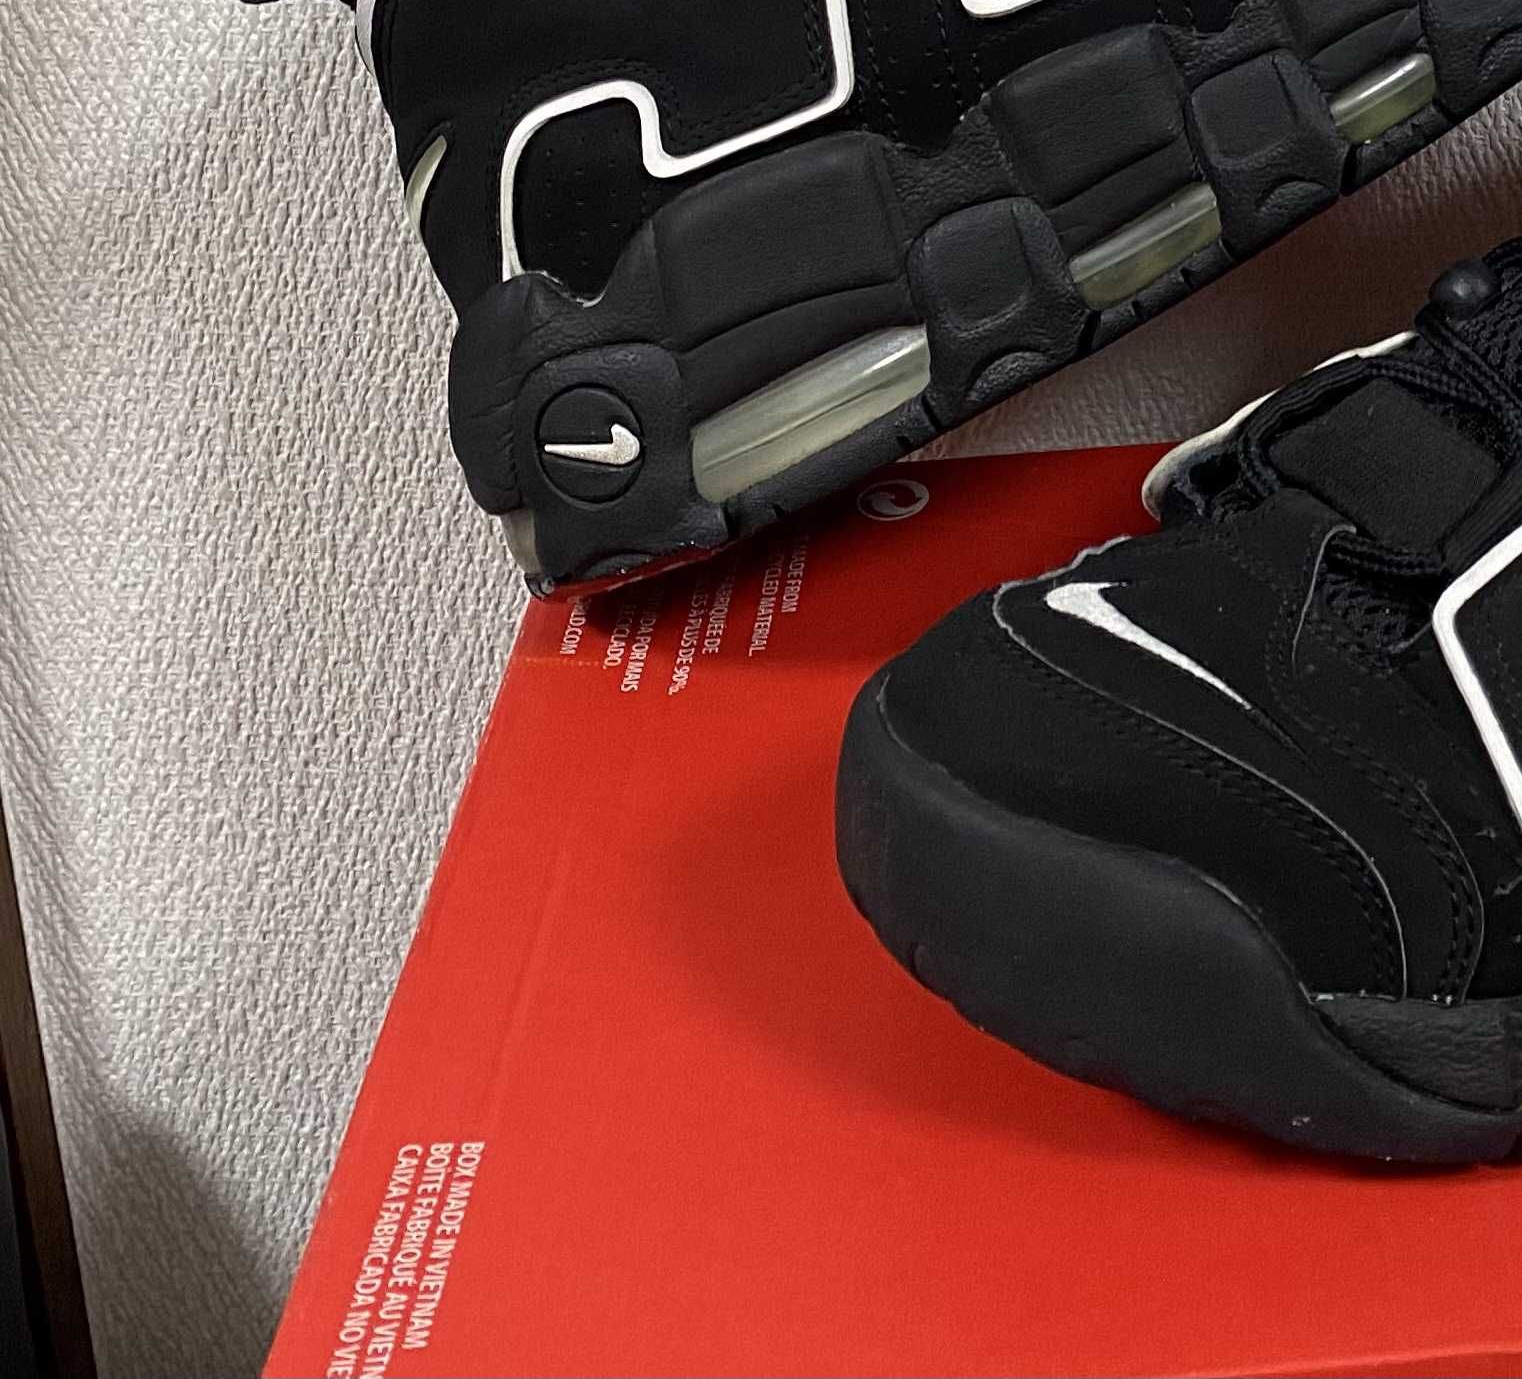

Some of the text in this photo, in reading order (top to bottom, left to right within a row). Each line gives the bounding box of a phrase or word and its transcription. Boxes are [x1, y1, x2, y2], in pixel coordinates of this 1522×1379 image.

[781, 580, 803, 613] FROM
[629, 636, 652, 660] POR
[681, 619, 703, 647] PLUS
[702, 638, 721, 655] DE
[676, 648, 695, 664] DE
[620, 662, 645, 693] MAIS
[385, 1144, 423, 1200] CAIXA
[350, 1201, 406, 1308] FABRICADA
[388, 1197, 438, 1288] FABRIQUÉ
[400, 1141, 486, 1350] BOX MADE IN VIETNAM
[379, 1292, 409, 1320] AU
[339, 1311, 372, 1344] NO
